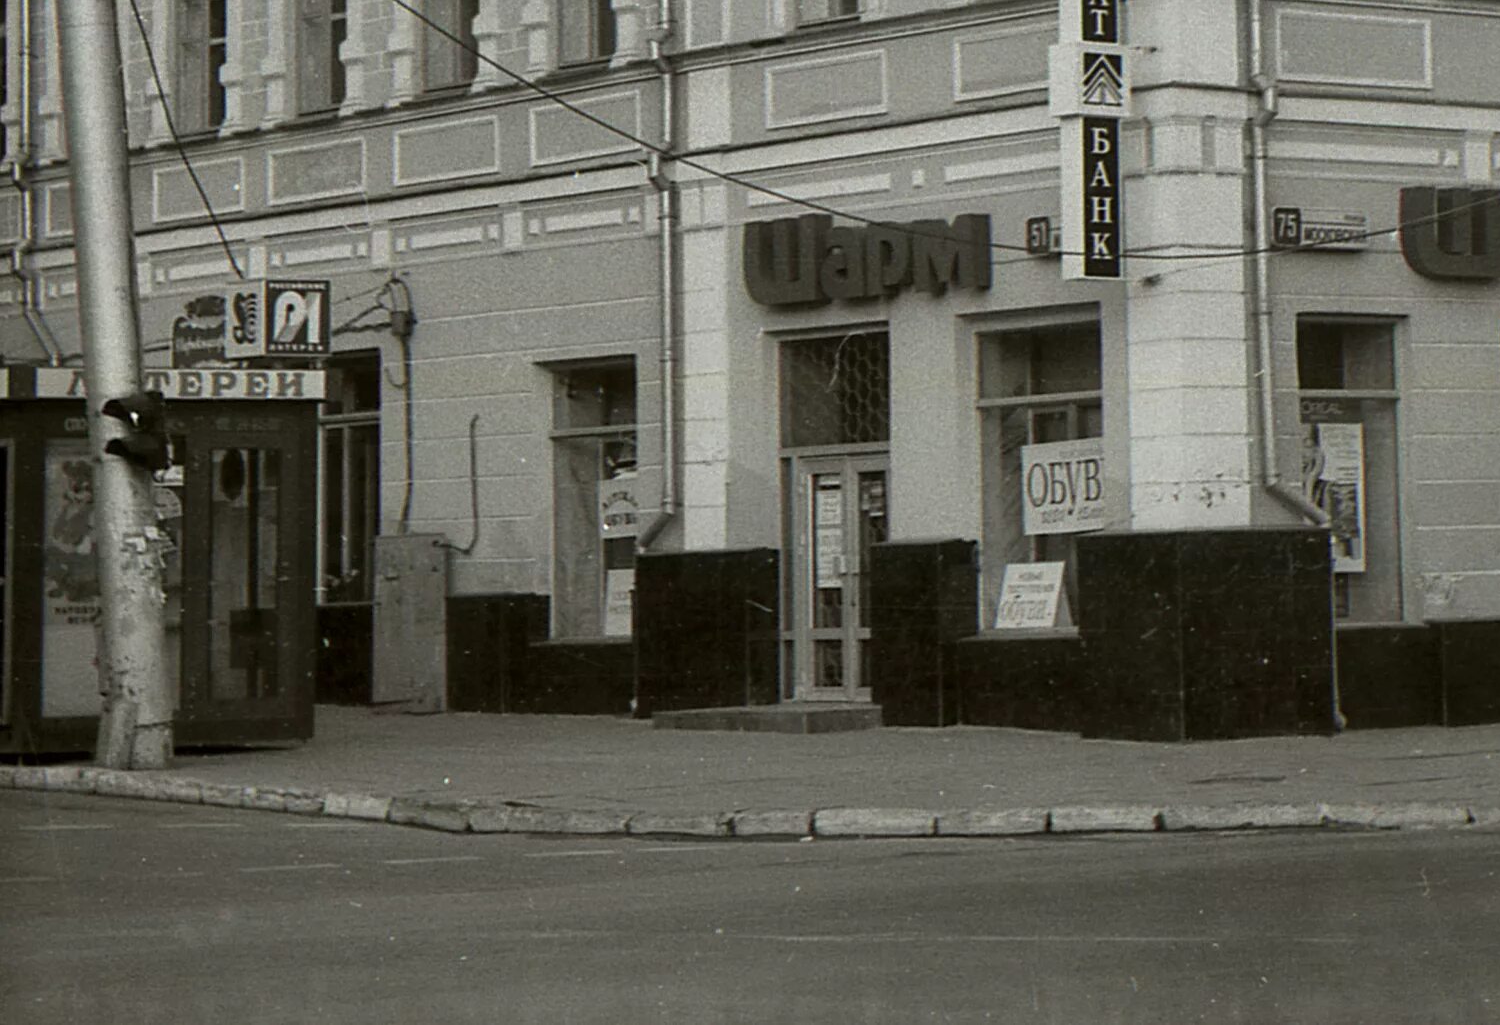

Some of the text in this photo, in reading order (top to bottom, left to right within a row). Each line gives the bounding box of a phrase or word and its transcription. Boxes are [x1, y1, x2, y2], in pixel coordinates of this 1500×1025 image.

[1089, 127, 1113, 261] БАНК
[1277, 213, 1298, 239] 75
[66, 371, 305, 396] ЛТЕРЕИ
[1026, 458, 1104, 516] ОБУВ
